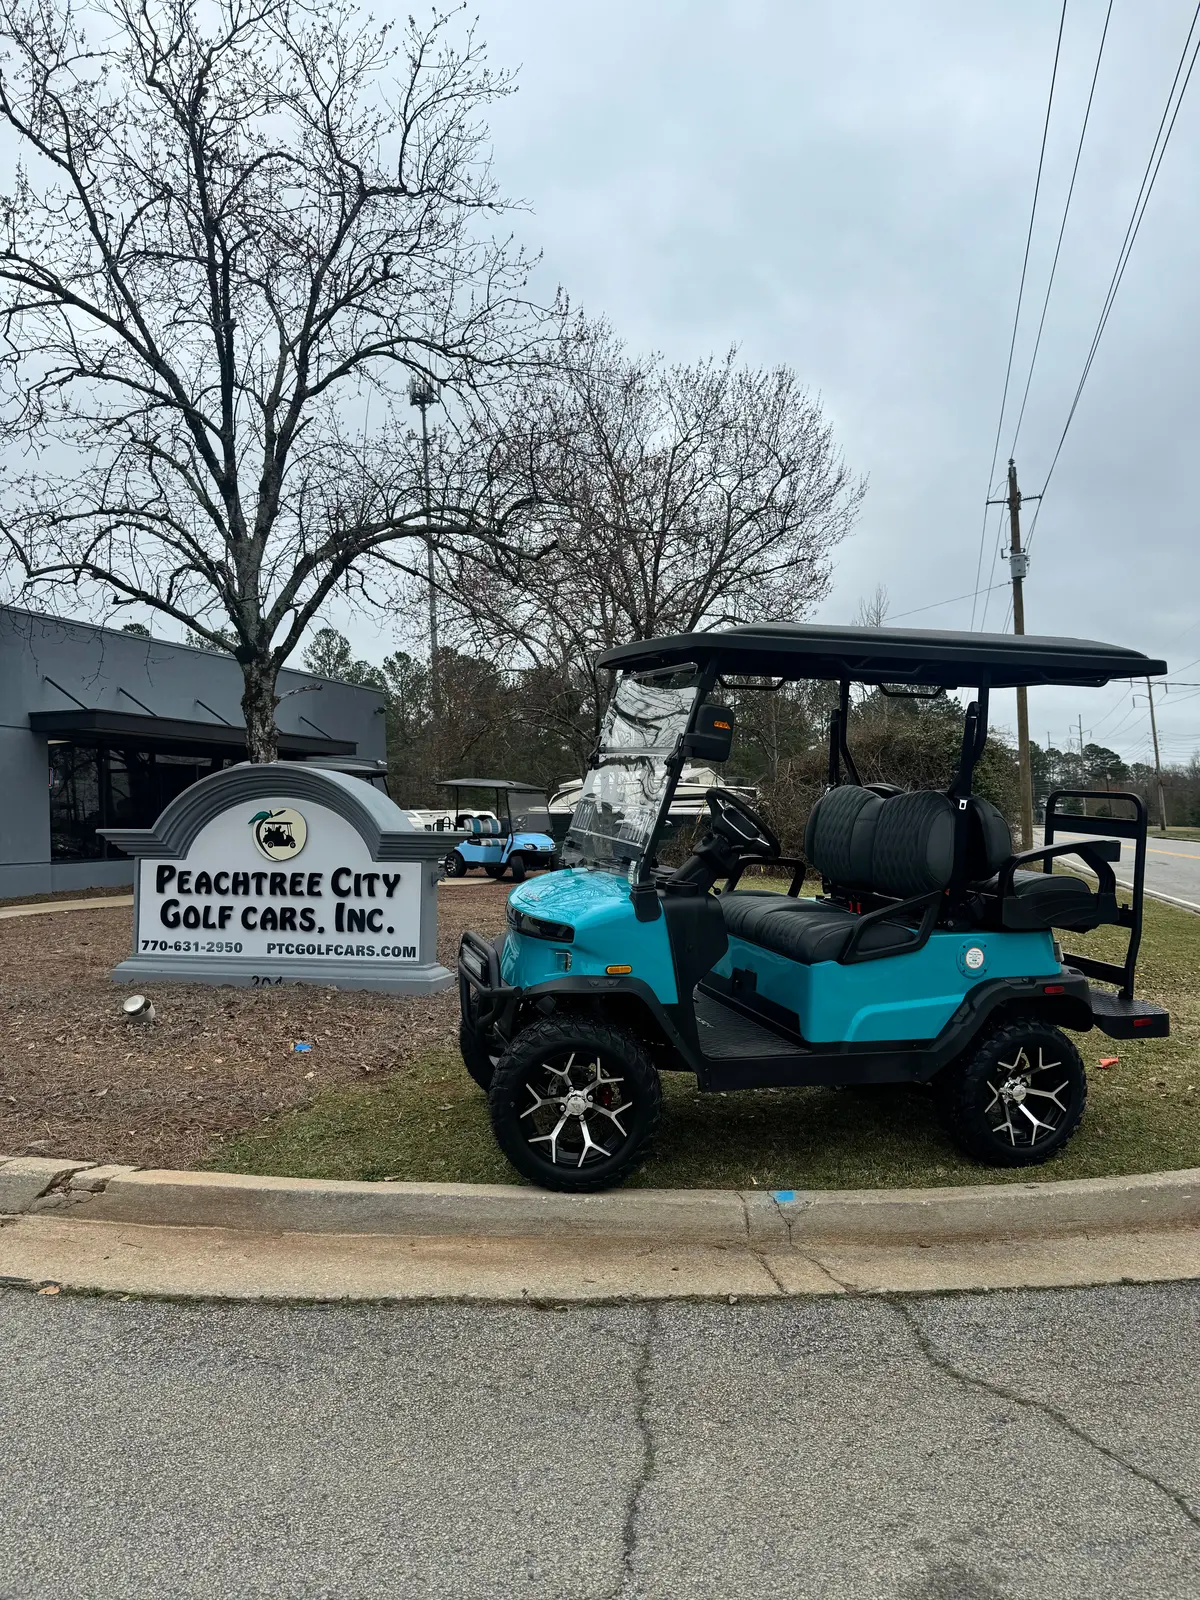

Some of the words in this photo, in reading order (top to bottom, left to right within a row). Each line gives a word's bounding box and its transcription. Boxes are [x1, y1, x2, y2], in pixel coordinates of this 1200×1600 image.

[156, 864, 324, 897] PEACHTREE
[331, 866, 401, 899] CITY
[160, 898, 234, 931] GOLF
[241, 906, 325, 935] CARS,
[335, 902, 395, 935] INC.
[141, 939, 243, 954] 770-631-2950
[267, 942, 417, 958] PTCGOLFCARS.COM
